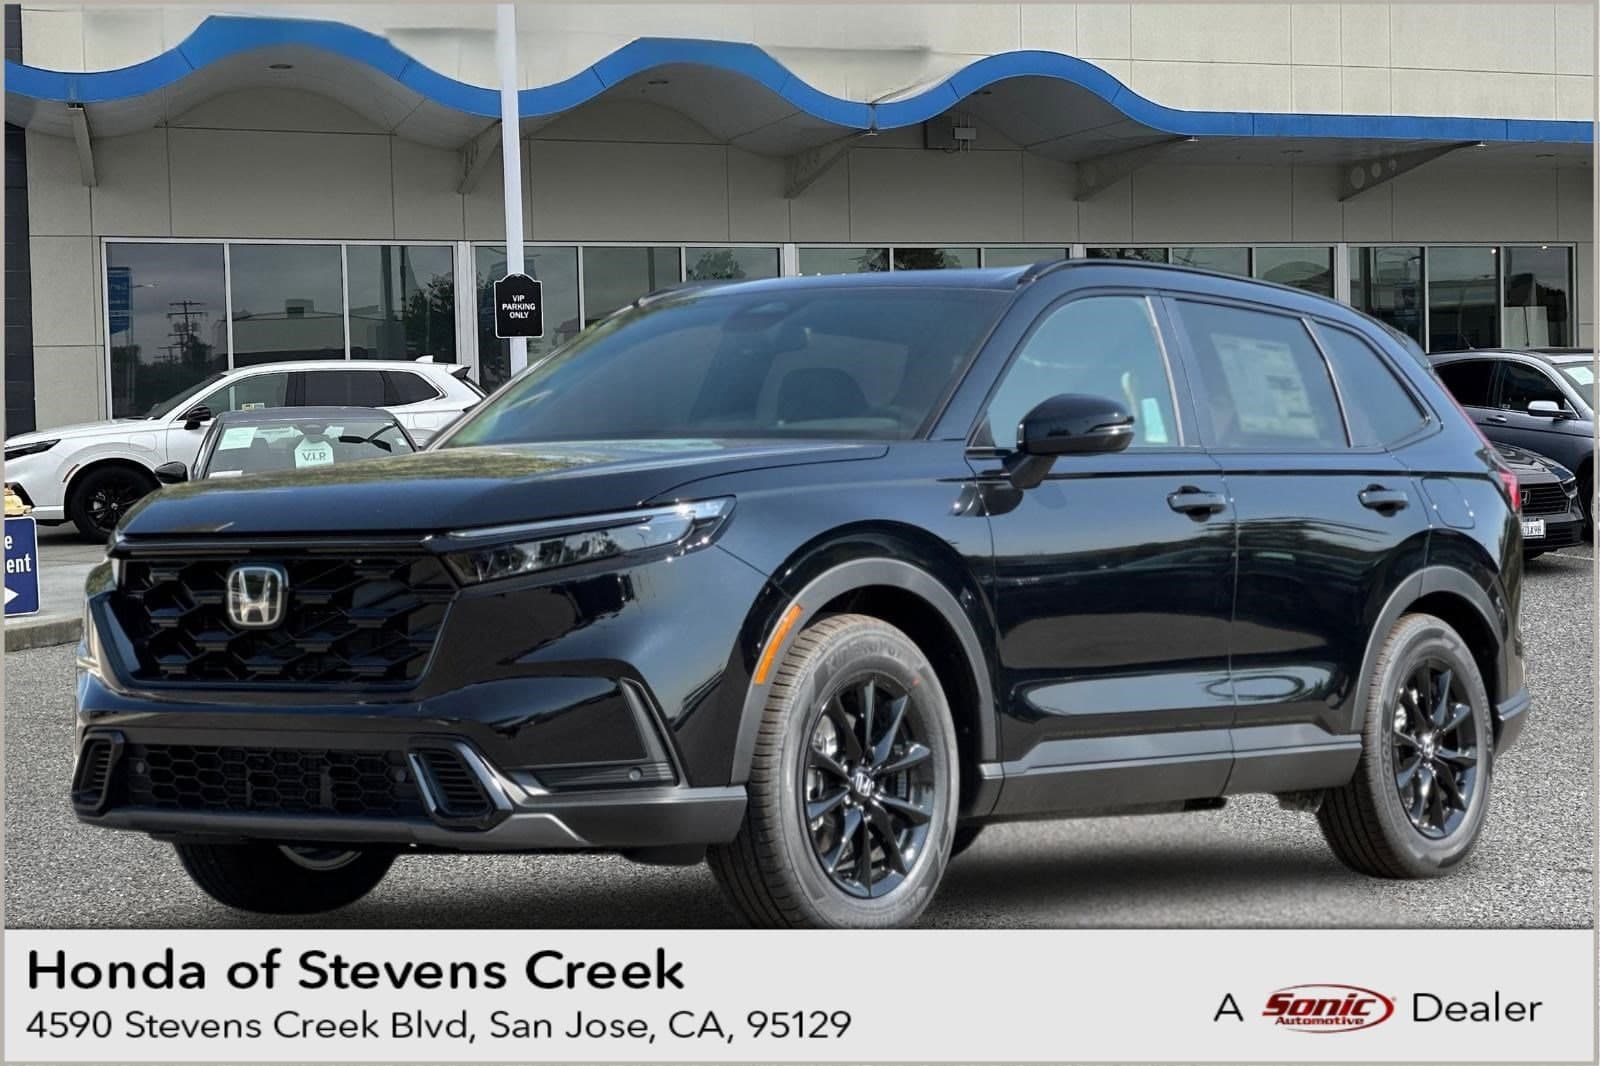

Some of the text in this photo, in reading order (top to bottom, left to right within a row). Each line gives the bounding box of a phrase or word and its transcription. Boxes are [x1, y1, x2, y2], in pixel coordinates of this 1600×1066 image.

[512, 294, 525, 302] VIP
[502, 303, 536, 311] PARKING
[509, 311, 529, 319] ONLY
